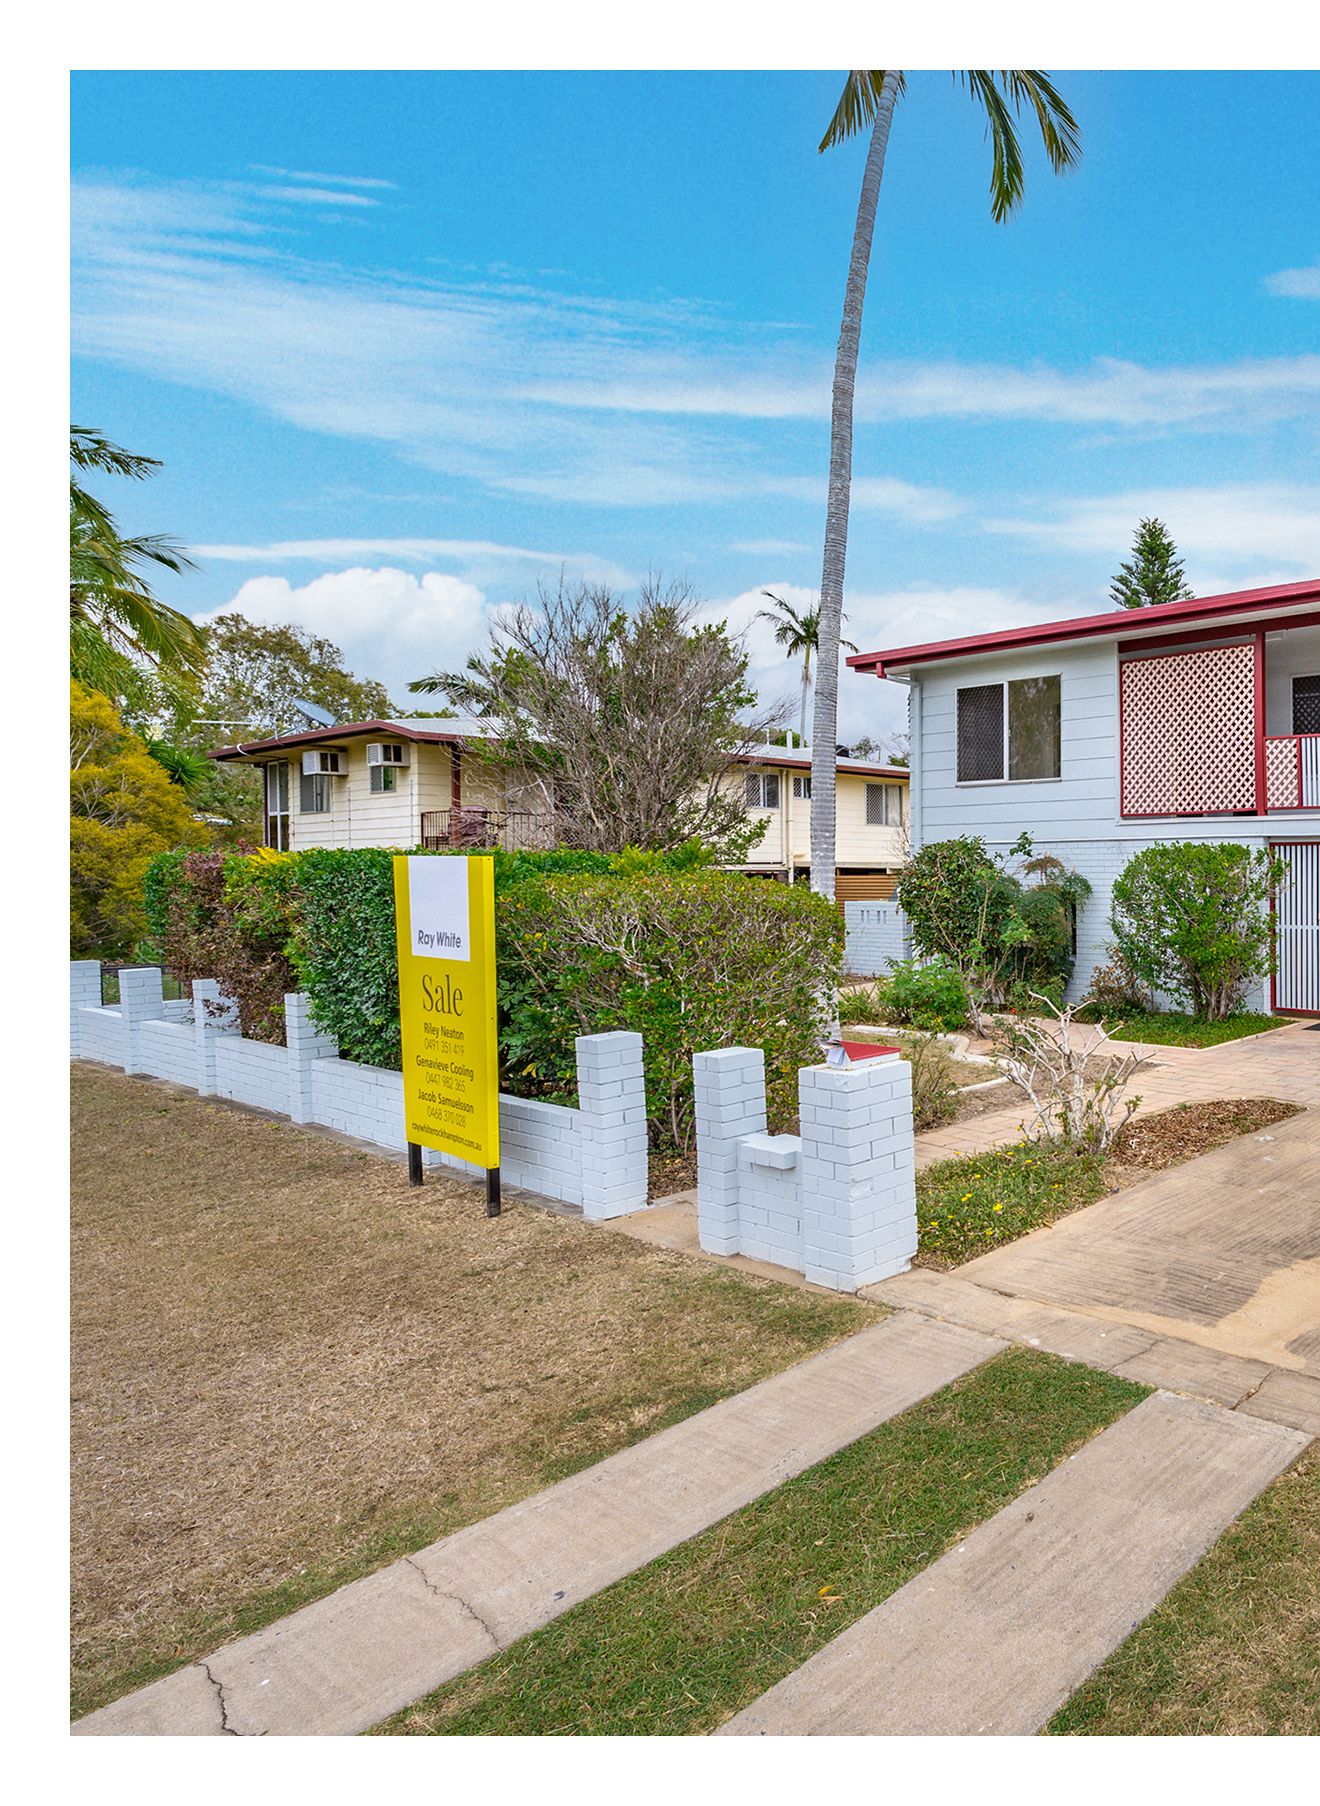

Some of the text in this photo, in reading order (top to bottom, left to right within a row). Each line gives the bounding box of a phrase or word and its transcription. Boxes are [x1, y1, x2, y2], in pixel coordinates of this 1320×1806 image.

[417, 929, 462, 949] Ray White
[422, 974, 464, 1017] Sale
[424, 1022, 465, 1040] Riley Neaton
[416, 1054, 474, 1082] Genavieve Cooling
[418, 1089, 474, 1114] Jacob Samuelsson
